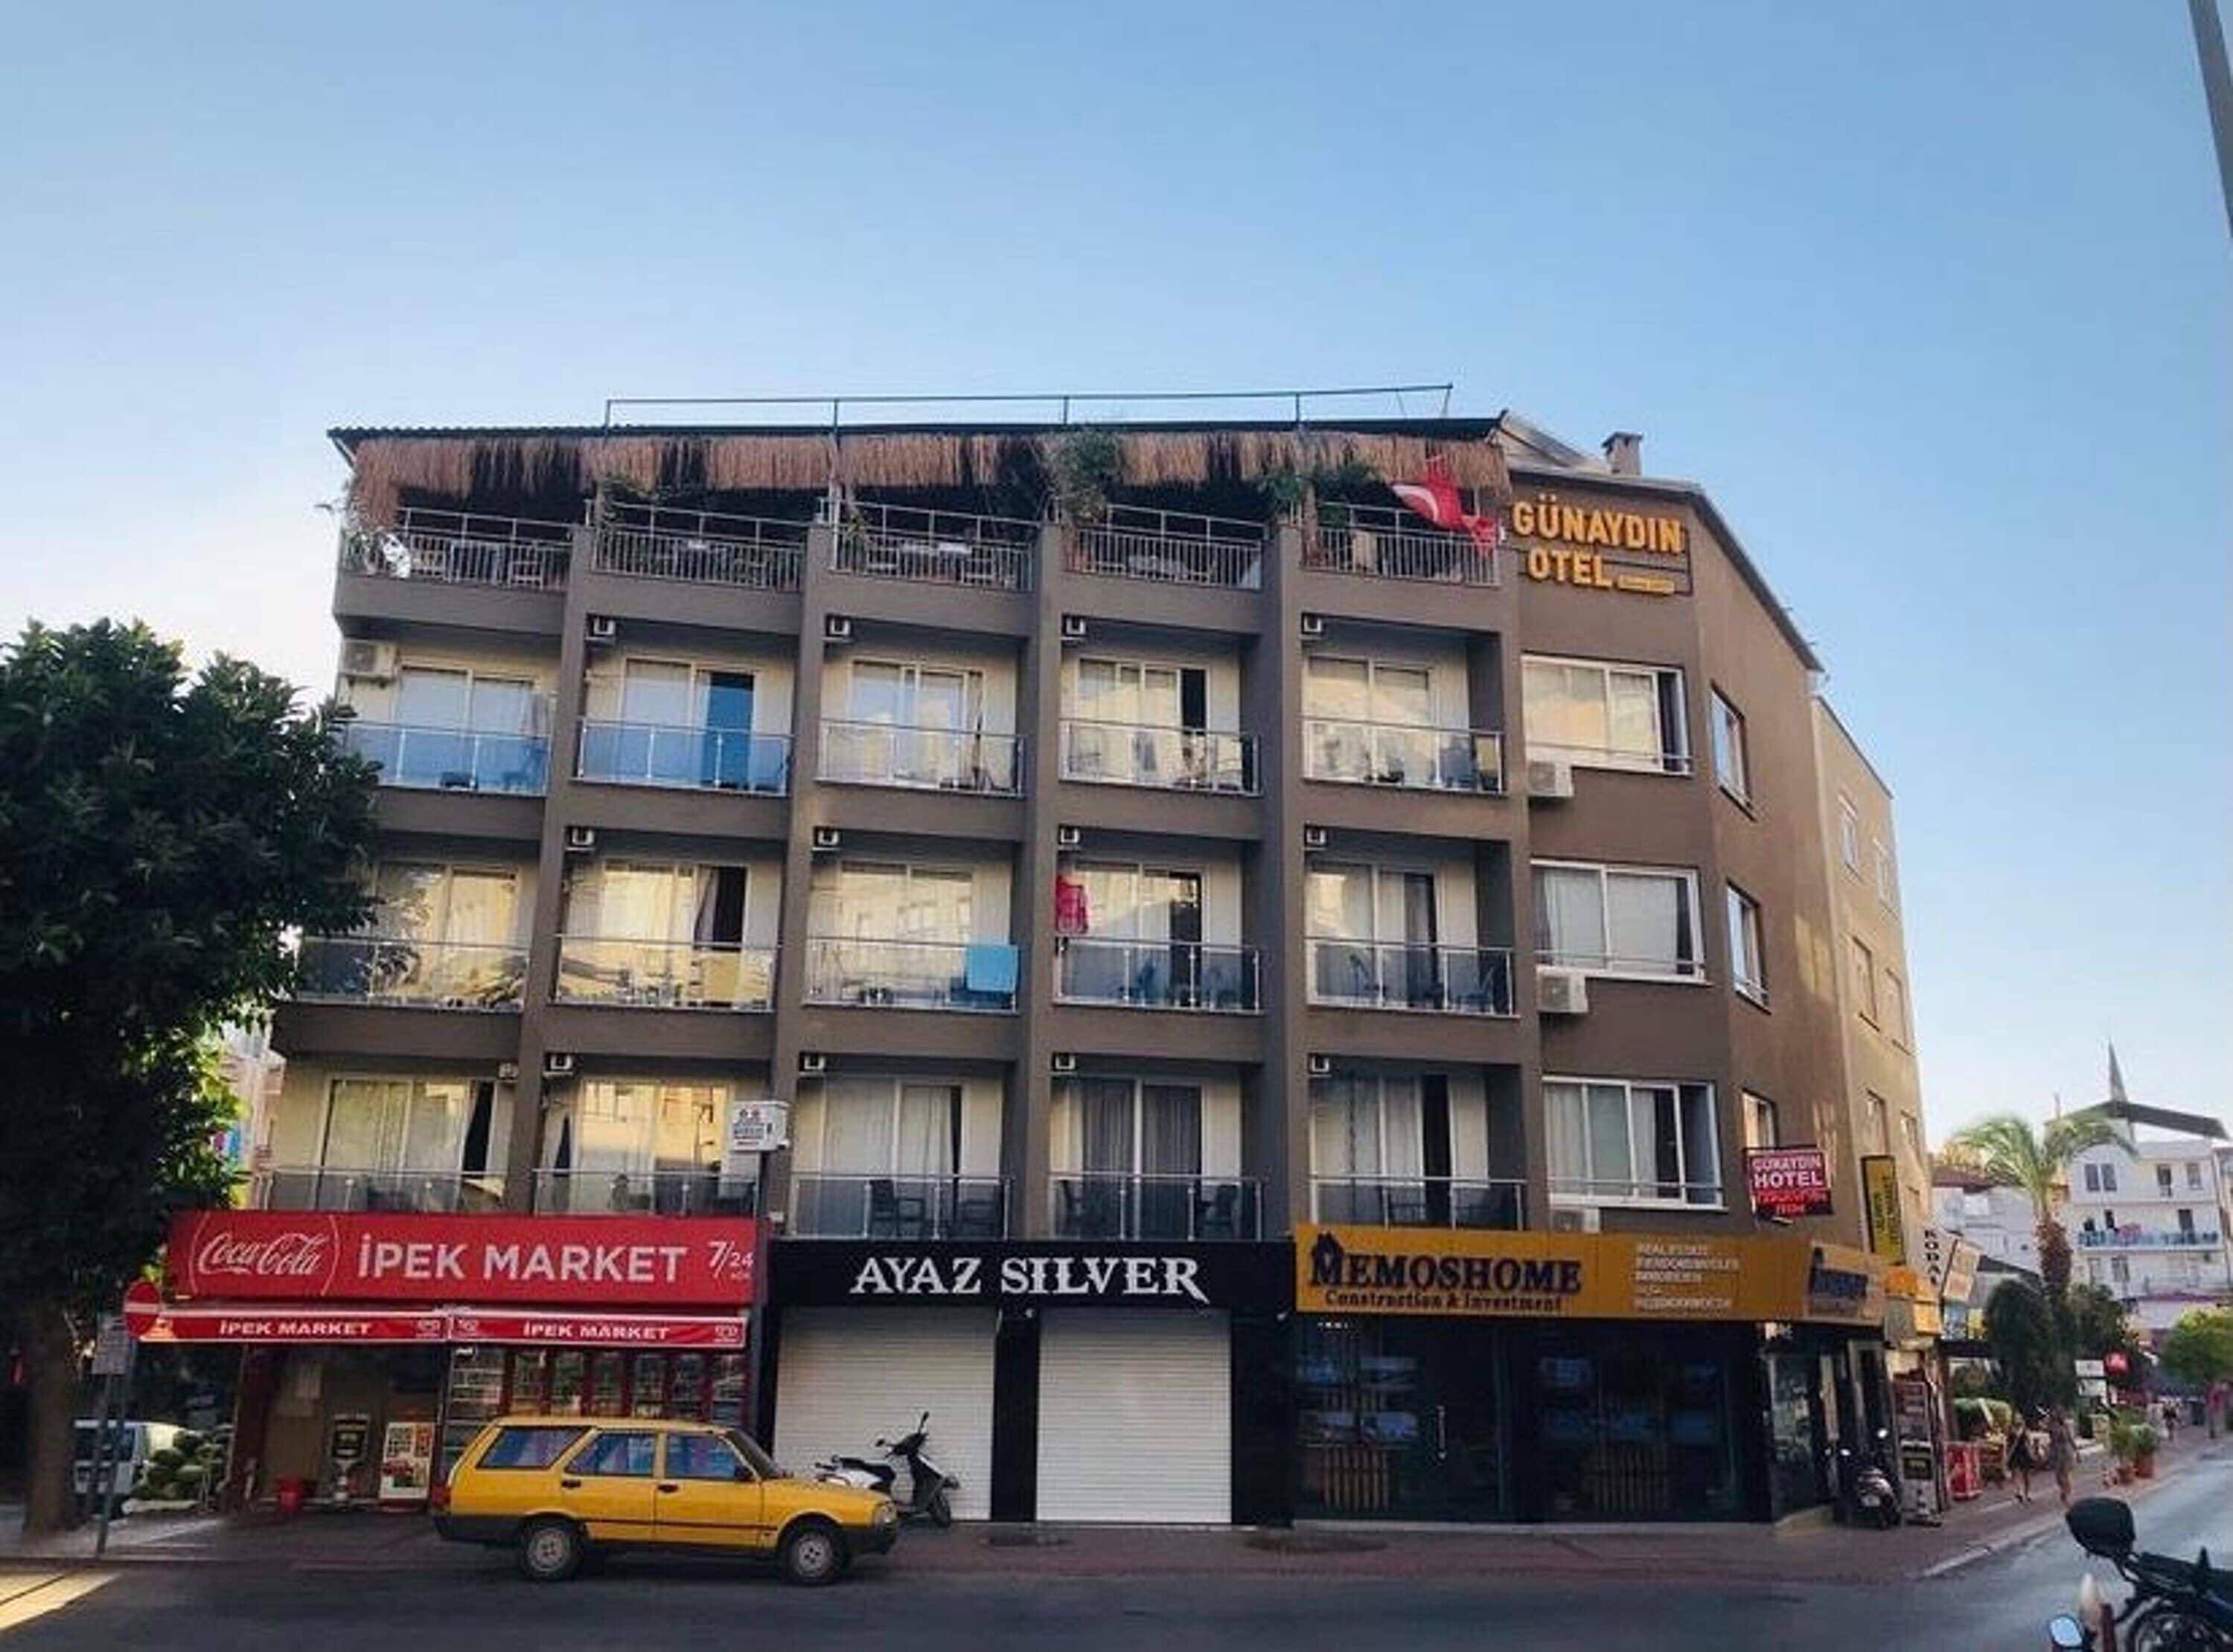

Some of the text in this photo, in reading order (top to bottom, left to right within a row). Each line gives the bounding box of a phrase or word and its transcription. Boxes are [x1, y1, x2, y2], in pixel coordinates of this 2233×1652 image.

[1512, 493, 1685, 554] GÜNAYDIN
[1528, 547, 1614, 587] OTEL
[1754, 1171, 1823, 1188] HOTEL
[199, 1232, 328, 1275] Coca-Cola
[358, 1232, 688, 1283] İPEK MARKET
[709, 1240, 754, 1278] 7/24
[849, 1257, 1210, 1304] AYAZ SILVER
[1447, 1293, 1459, 1307] &
[220, 1319, 371, 1336] İPEK MARKET
[523, 1322, 671, 1340] İPEK MARKET
